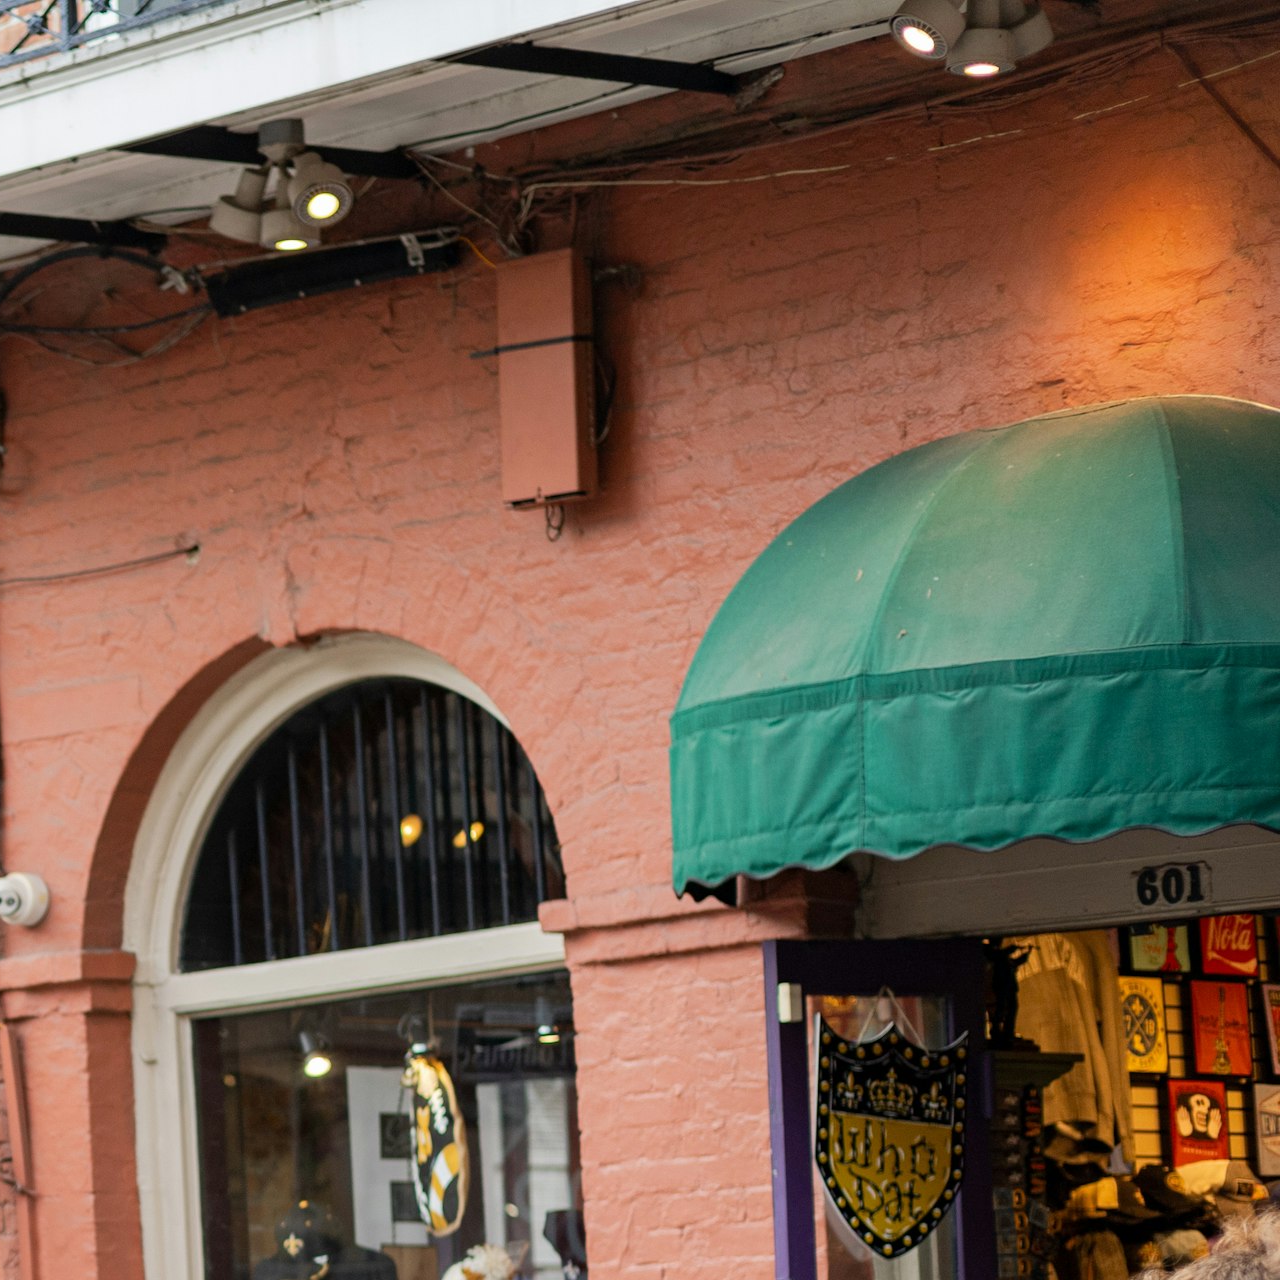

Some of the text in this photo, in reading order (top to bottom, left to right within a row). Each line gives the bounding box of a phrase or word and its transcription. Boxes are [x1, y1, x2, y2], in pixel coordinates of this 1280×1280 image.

[1137, 865, 1204, 906] 601
[833, 1115, 937, 1183] Who
[848, 1166, 922, 1223] Dat
